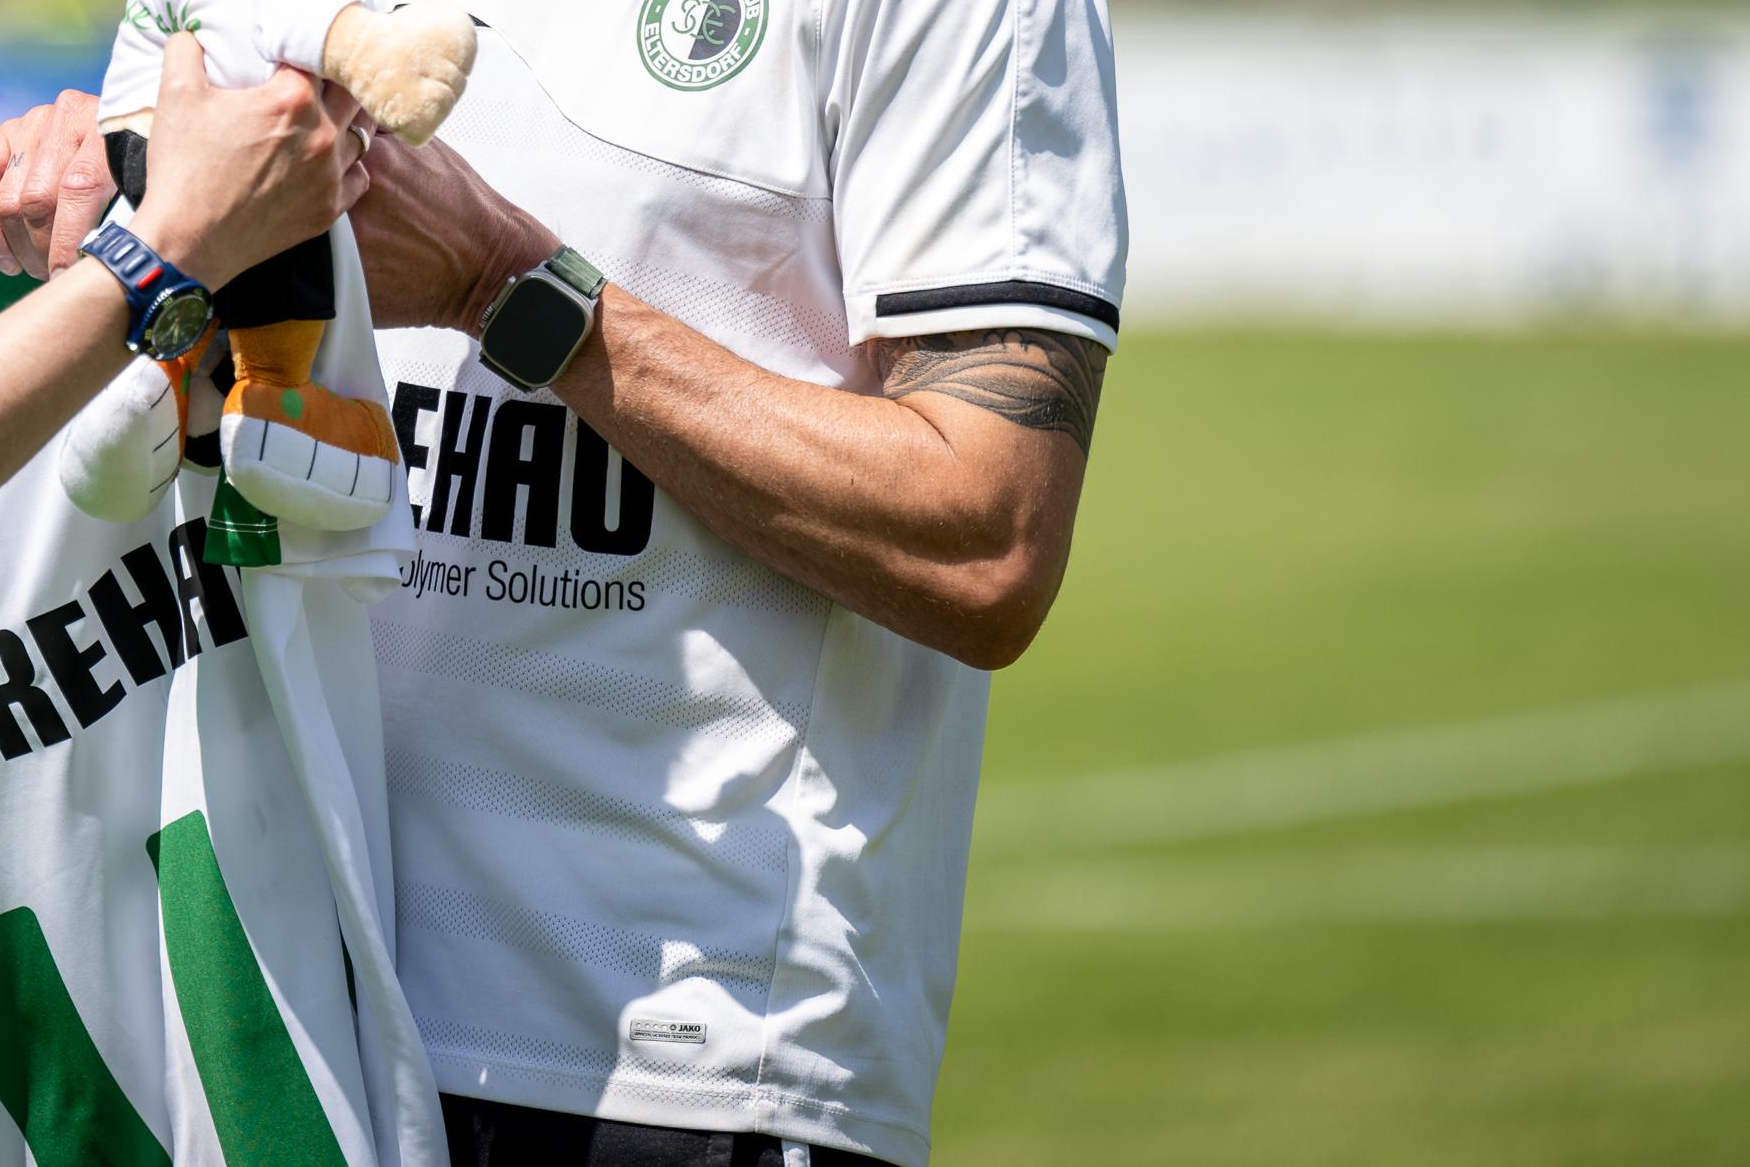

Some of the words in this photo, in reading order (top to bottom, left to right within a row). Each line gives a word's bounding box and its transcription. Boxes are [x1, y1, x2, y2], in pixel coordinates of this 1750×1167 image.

[644, 22, 743, 83] ELTERSDORF
[392, 381, 655, 556] EHAU
[399, 549, 477, 599] olymer
[486, 560, 646, 611] Solutions
[678, 1024, 701, 1033] JAKO
